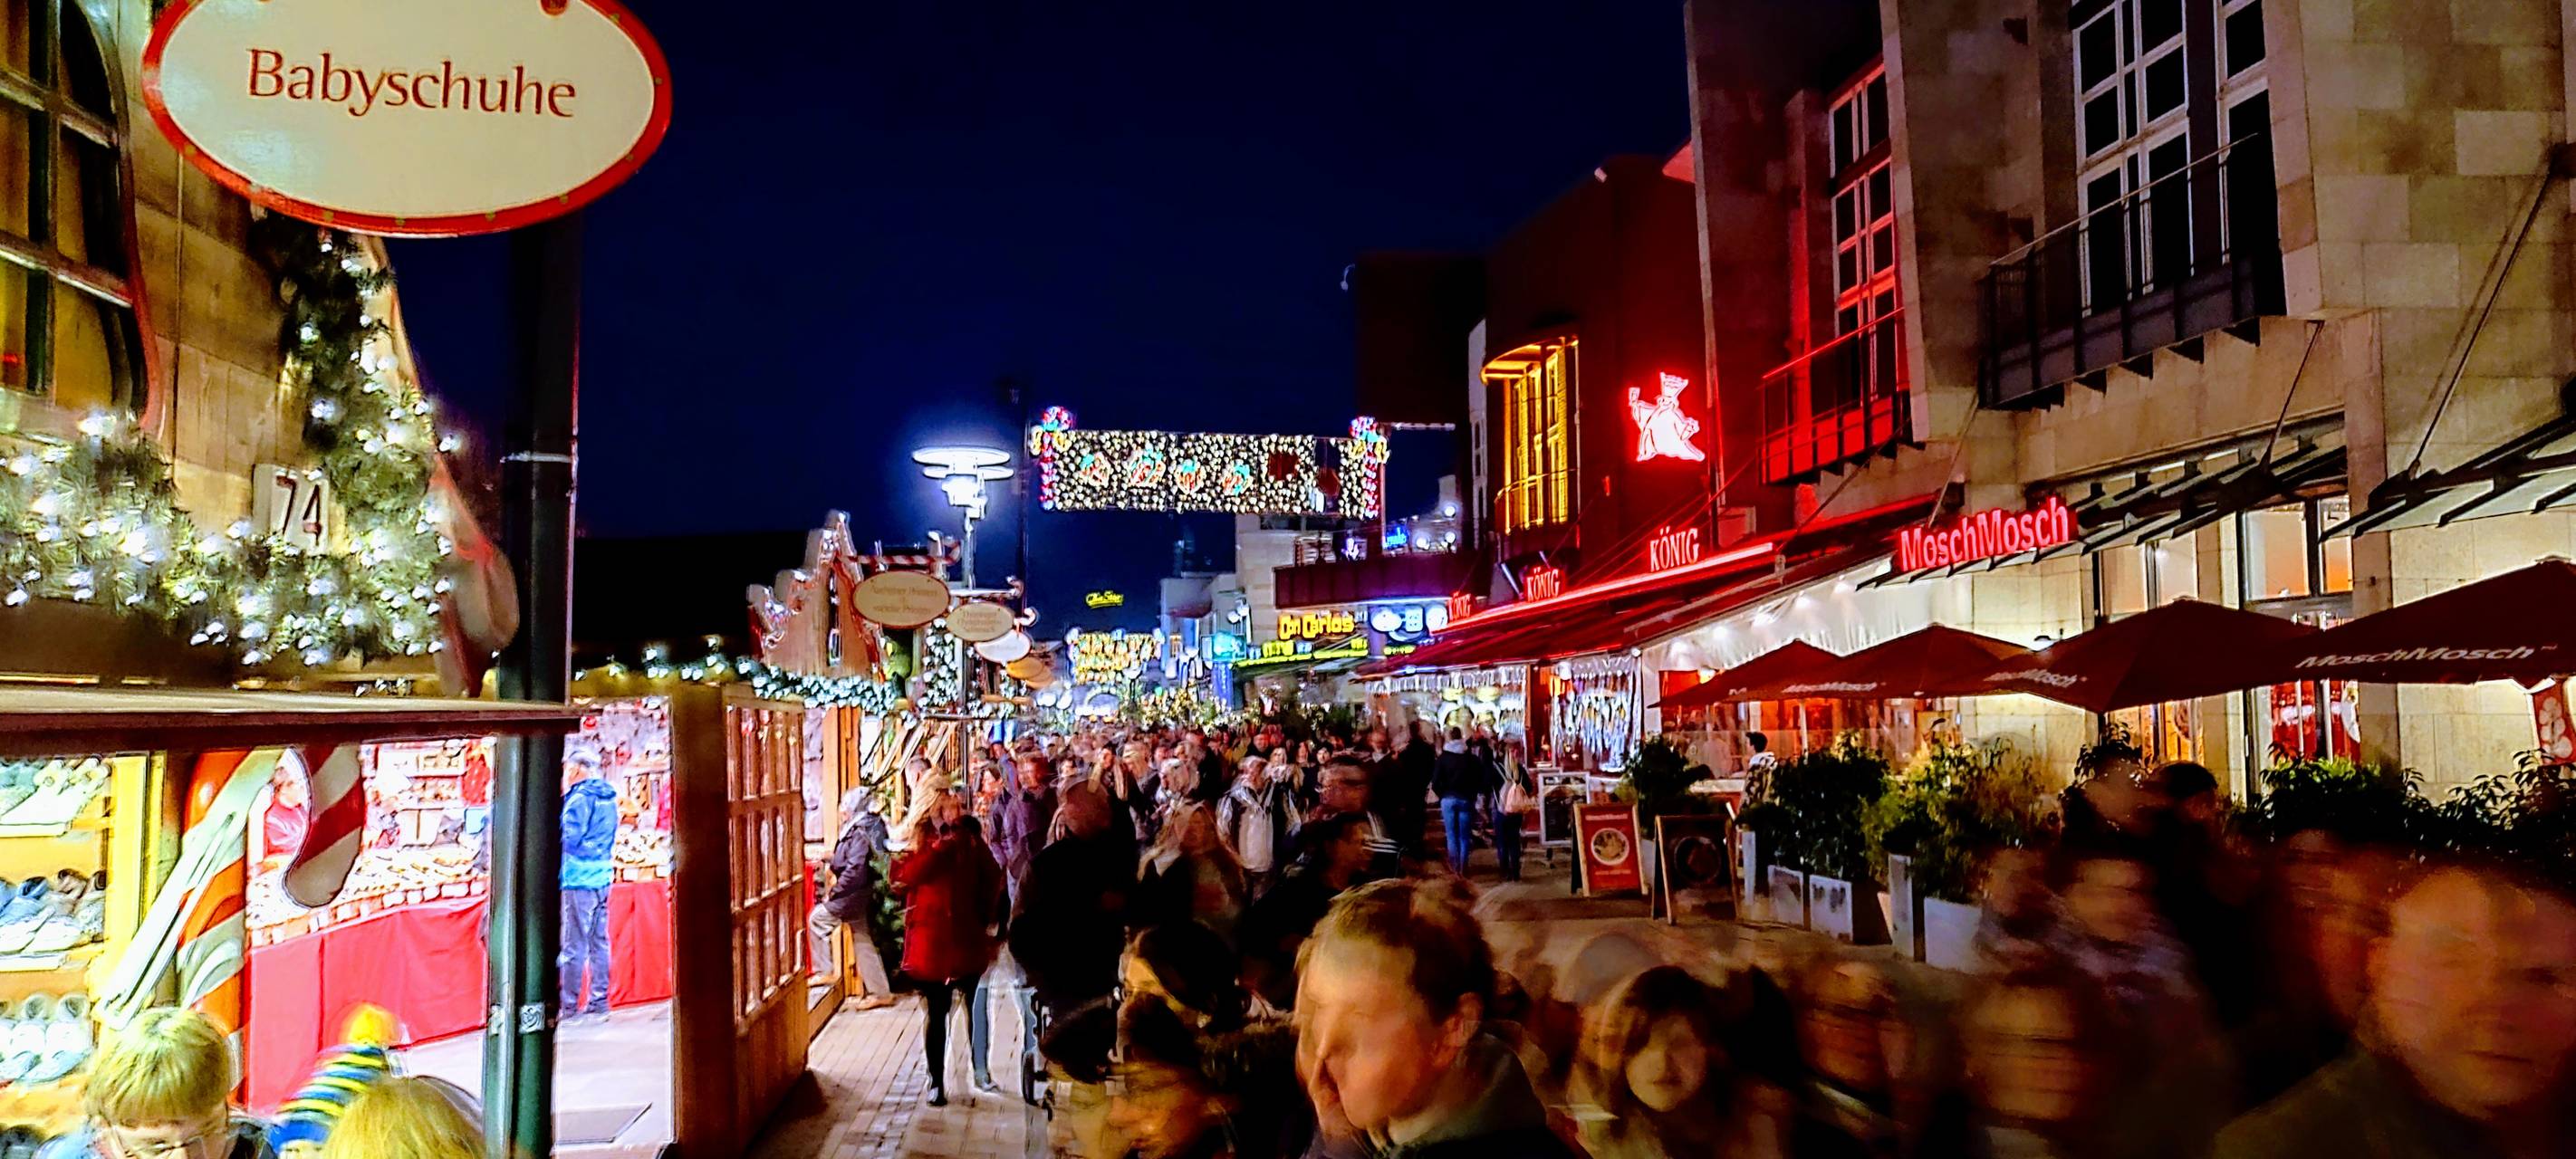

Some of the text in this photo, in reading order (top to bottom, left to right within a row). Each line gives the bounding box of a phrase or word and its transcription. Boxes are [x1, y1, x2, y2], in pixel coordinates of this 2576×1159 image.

[246, 47, 577, 117] Babyschuhe
[275, 475, 322, 546] 74
[1899, 495, 2070, 572] MoschMosch
[1648, 525, 1700, 572] KÖNIG
[1526, 566, 1561, 602] KÖNIG
[1302, 611, 1355, 639] Carlos
[2294, 637, 2535, 669] MoschMosch
